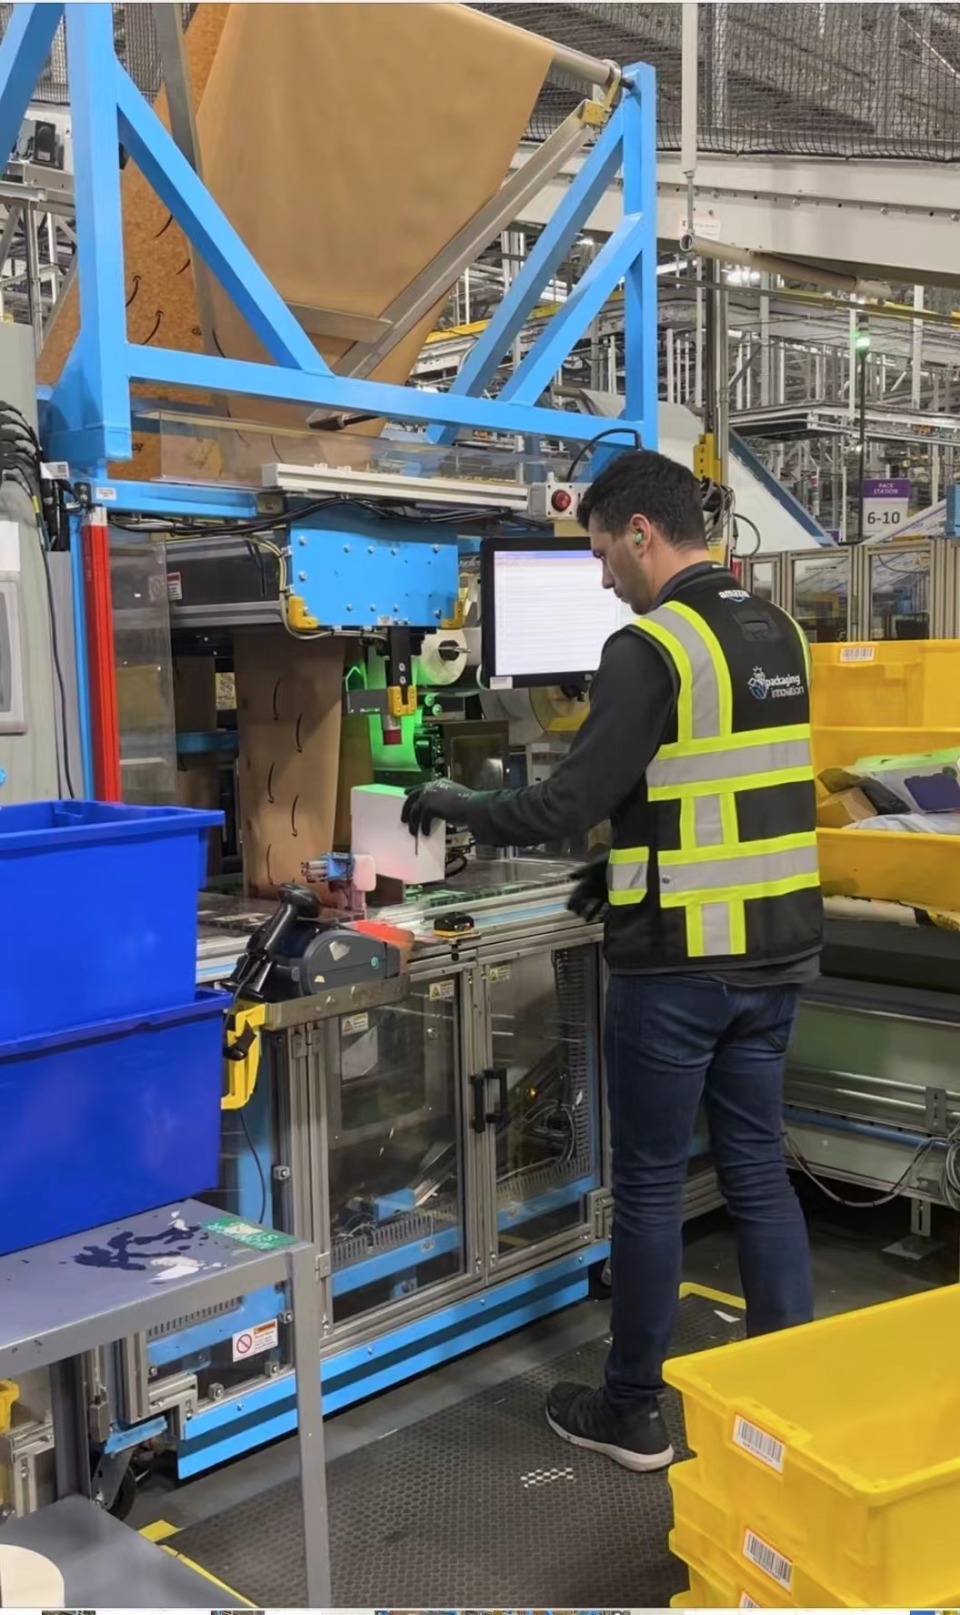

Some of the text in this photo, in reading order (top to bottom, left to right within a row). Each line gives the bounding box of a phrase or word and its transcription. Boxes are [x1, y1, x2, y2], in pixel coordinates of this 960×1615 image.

[867, 511, 901, 524] 6-10
[765, 674, 801, 688] packaging
[771, 685, 804, 698] innovation
